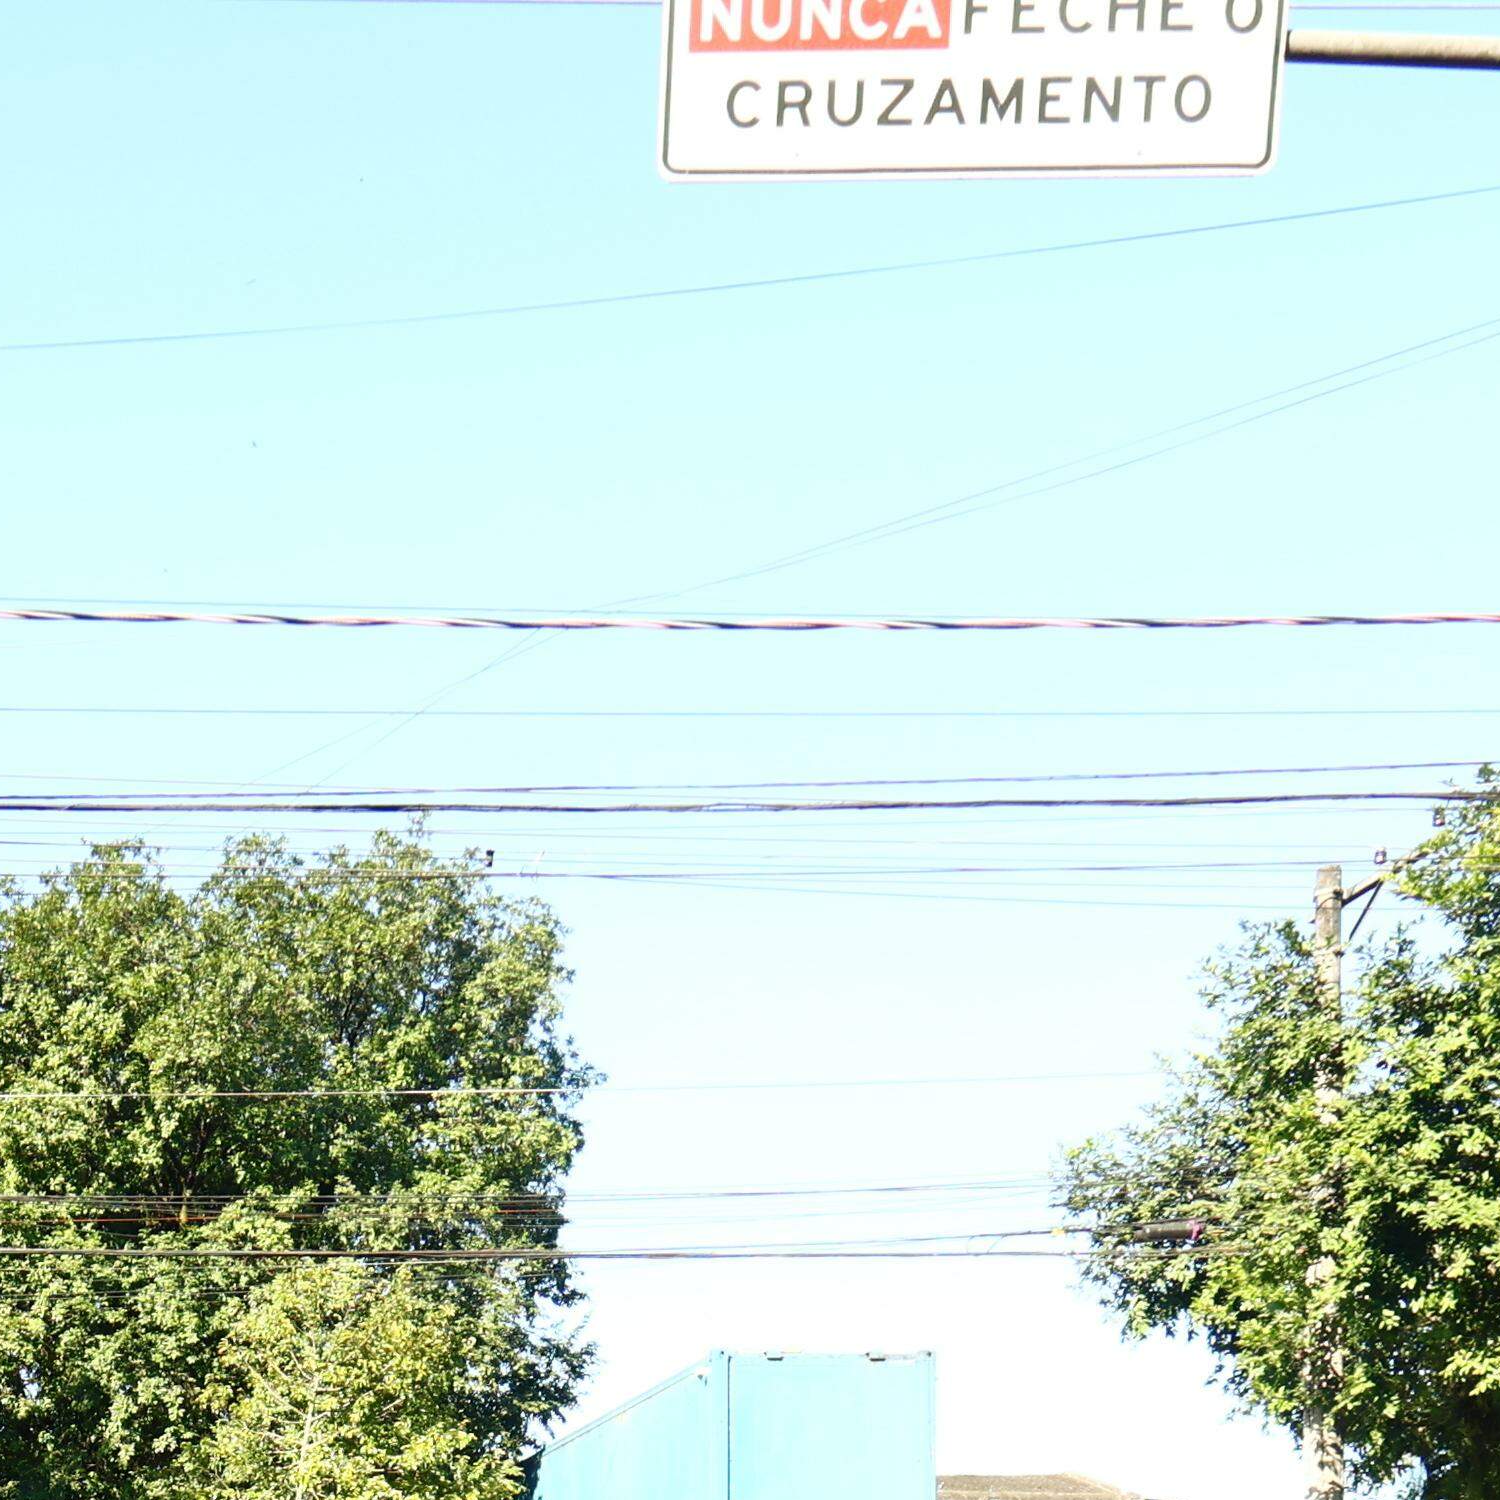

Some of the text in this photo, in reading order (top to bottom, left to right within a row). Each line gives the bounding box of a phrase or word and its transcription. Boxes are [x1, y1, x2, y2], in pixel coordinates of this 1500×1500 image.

[698, 0, 1265, 43] NUNCA FECHE O
[725, 74, 1213, 129] CRUZAMENTO
